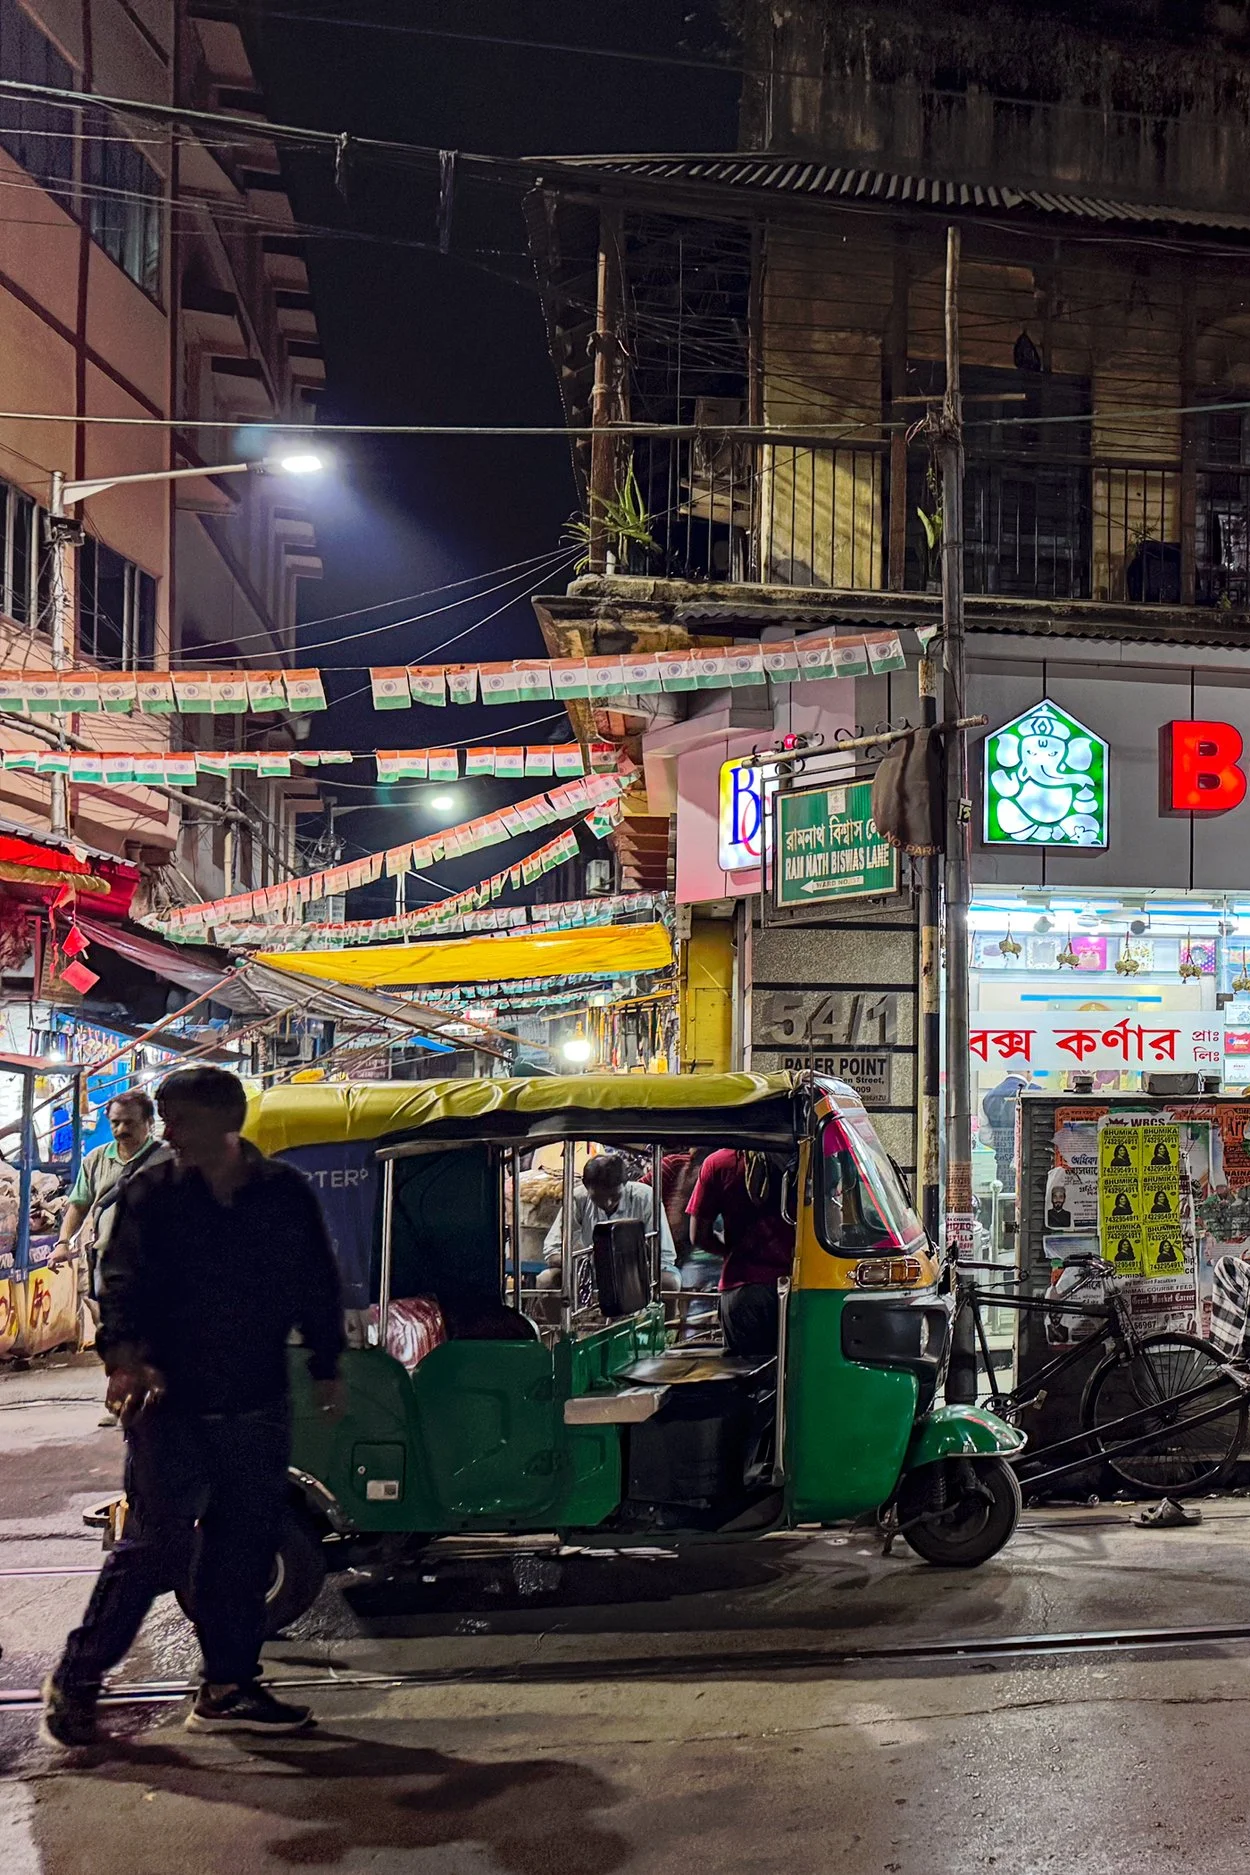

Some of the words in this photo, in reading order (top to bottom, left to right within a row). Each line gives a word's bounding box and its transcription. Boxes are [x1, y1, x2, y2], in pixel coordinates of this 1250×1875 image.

[785, 824, 826, 852] রামনাথ
[829, 815, 865, 847] বিশ্বাস
[785, 855, 804, 880] RAM
[805, 852, 829, 877] NATH
[831, 847, 865, 874] BISWAS
[867, 842, 890, 869] LANE
[766, 994, 898, 1044] 54/1
[1052, 1017, 1182, 1062] কর্ণার
[840, 1057, 887, 1075] POINT
[856, 1076, 885, 1085] Street,
[1131, 1118, 1166, 1127] WBCS
[1103, 1129, 1139, 1137] BHUMIKA
[1104, 1177, 1139, 1185] BHUMIKA
[1143, 1175, 1178, 1183] BHUMIKA
[1147, 1224, 1182, 1233] BHUMIKA
